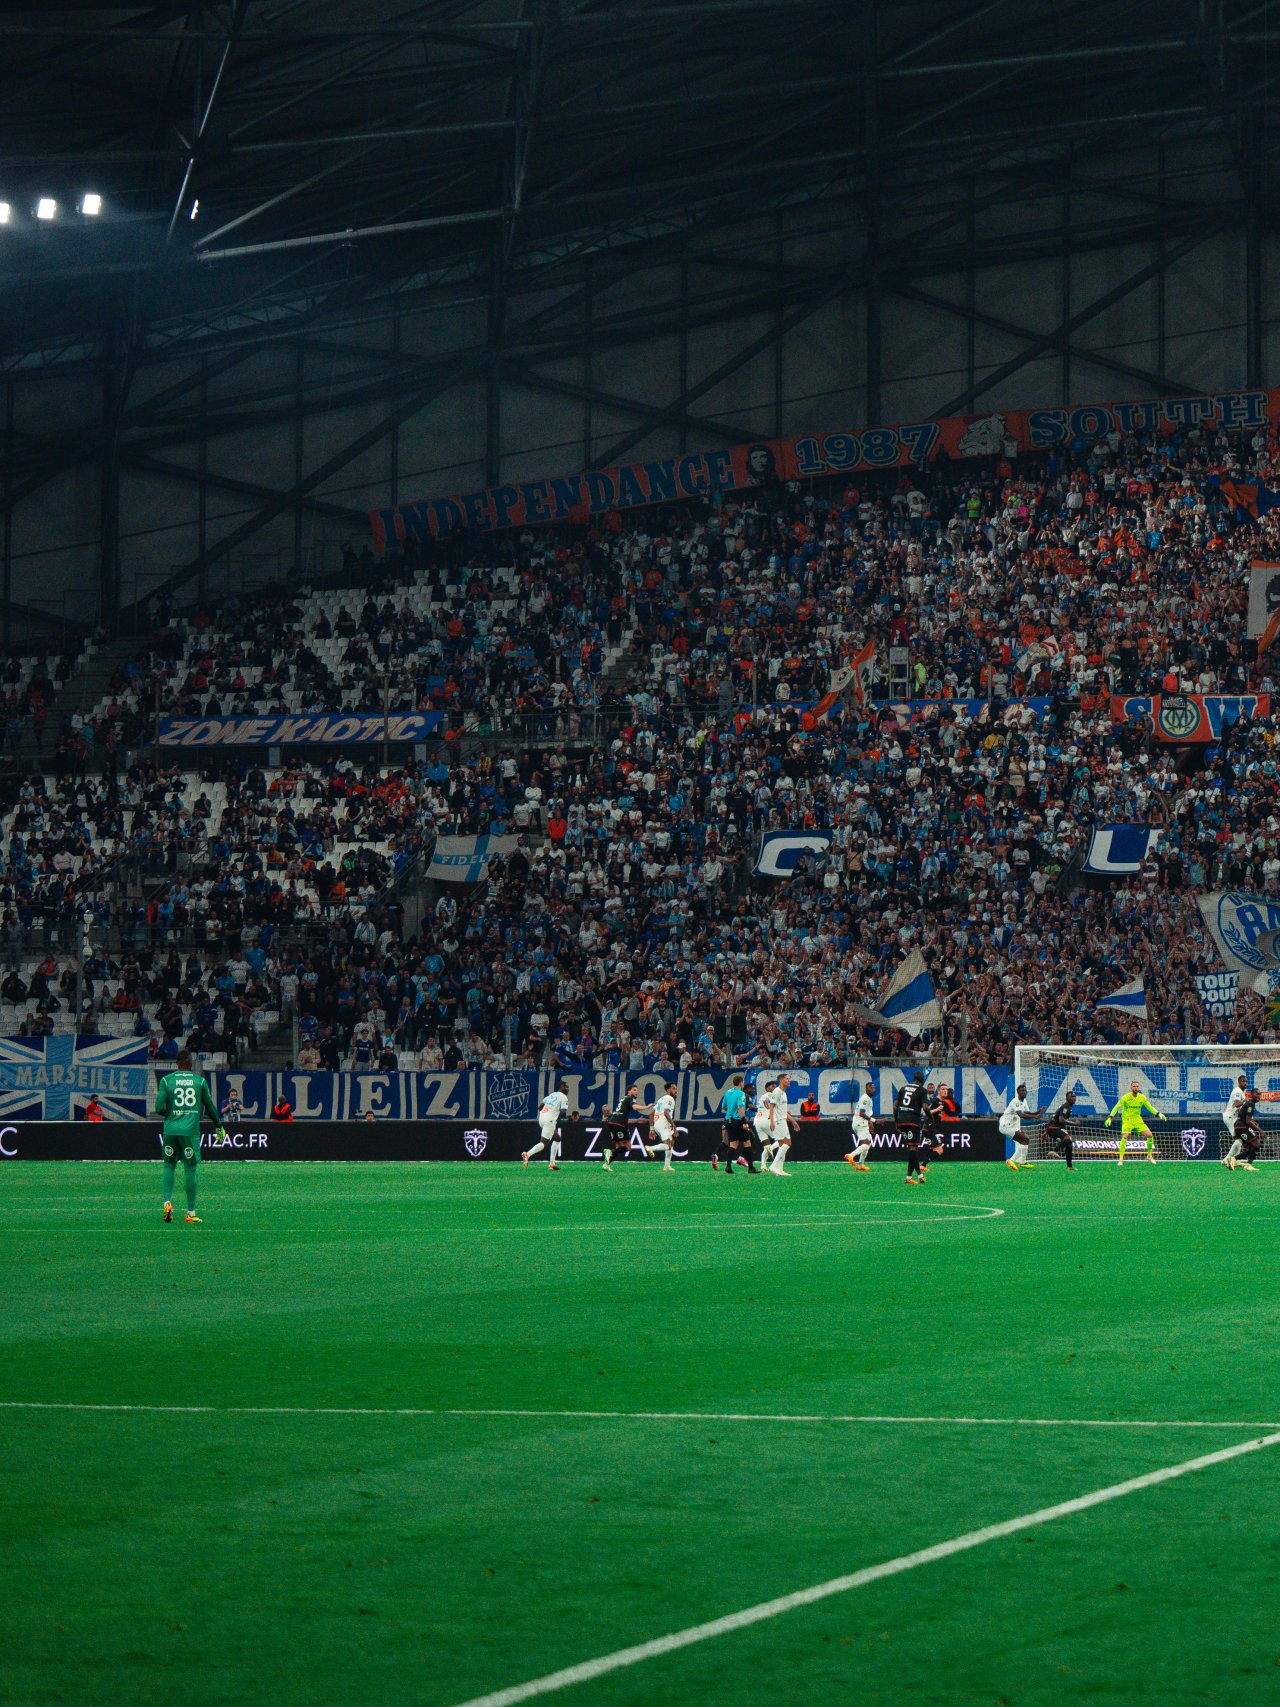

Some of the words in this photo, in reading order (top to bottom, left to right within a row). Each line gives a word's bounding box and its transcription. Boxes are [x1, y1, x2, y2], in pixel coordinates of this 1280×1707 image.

[1028, 391, 1269, 448] SOUTH
[795, 422, 941, 477] 1987
[380, 451, 735, 547] INDEPENDANCE
[155, 719, 276, 745] ZONE
[265, 716, 426, 743] KAOTIC
[441, 854, 492, 865] FIDEL
[15, 1063, 129, 1092] MARSEILLE
[174, 1087, 197, 1107] 38
[902, 1092, 912, 1106] 5
[159, 1133, 268, 1148] .IZAC.FR
